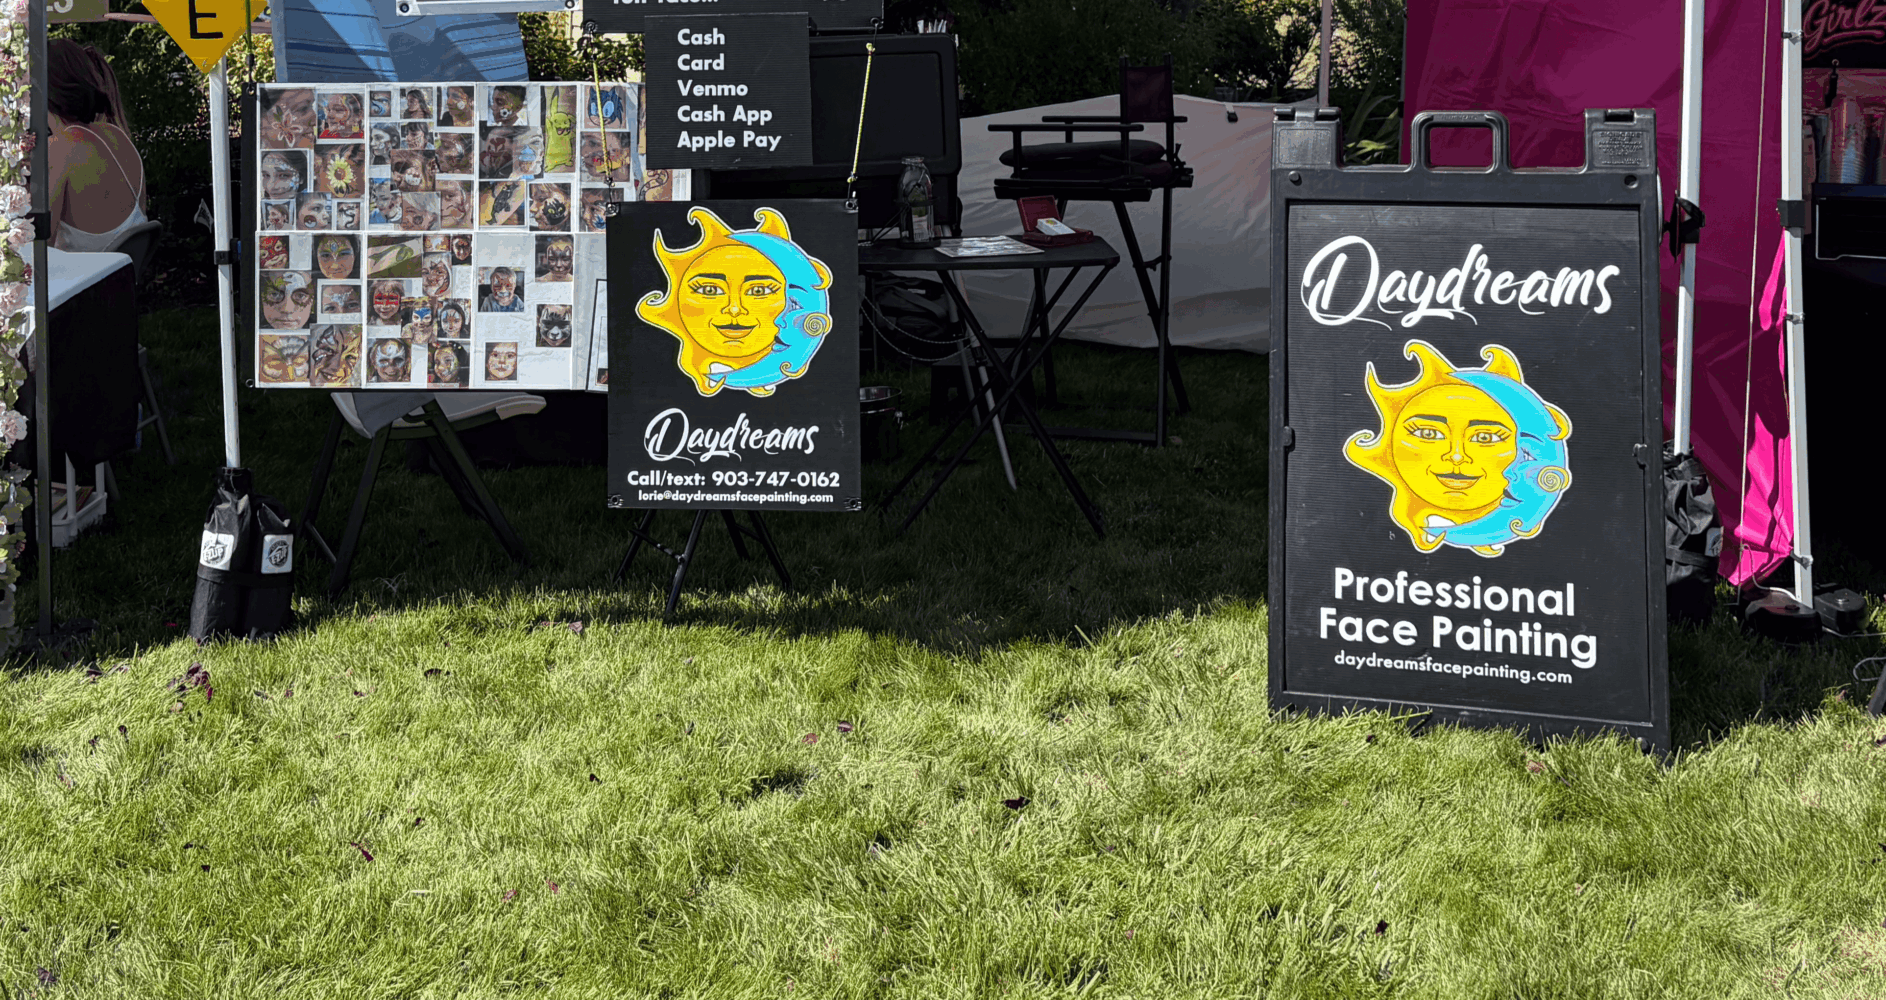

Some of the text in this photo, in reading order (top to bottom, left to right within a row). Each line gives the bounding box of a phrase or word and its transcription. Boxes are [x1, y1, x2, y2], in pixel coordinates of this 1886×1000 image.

[677, 28, 725, 46] Cash
[677, 53, 725, 71] Card
[677, 80, 748, 97] Venmo
[677, 105, 773, 126] Cash App
[677, 130, 782, 152] Apple Pay
[1300, 236, 1619, 330] Daydreams
[644, 408, 820, 466] Daydreams
[627, 470, 840, 487] Call/text: 903-747-0162
[638, 490, 834, 504] lorie@daydreamsfacepainting.com
[1334, 568, 1575, 616] Professional
[1320, 607, 1597, 670] Face Painting
[1334, 651, 1574, 685] daydreamsfacepainting.com
